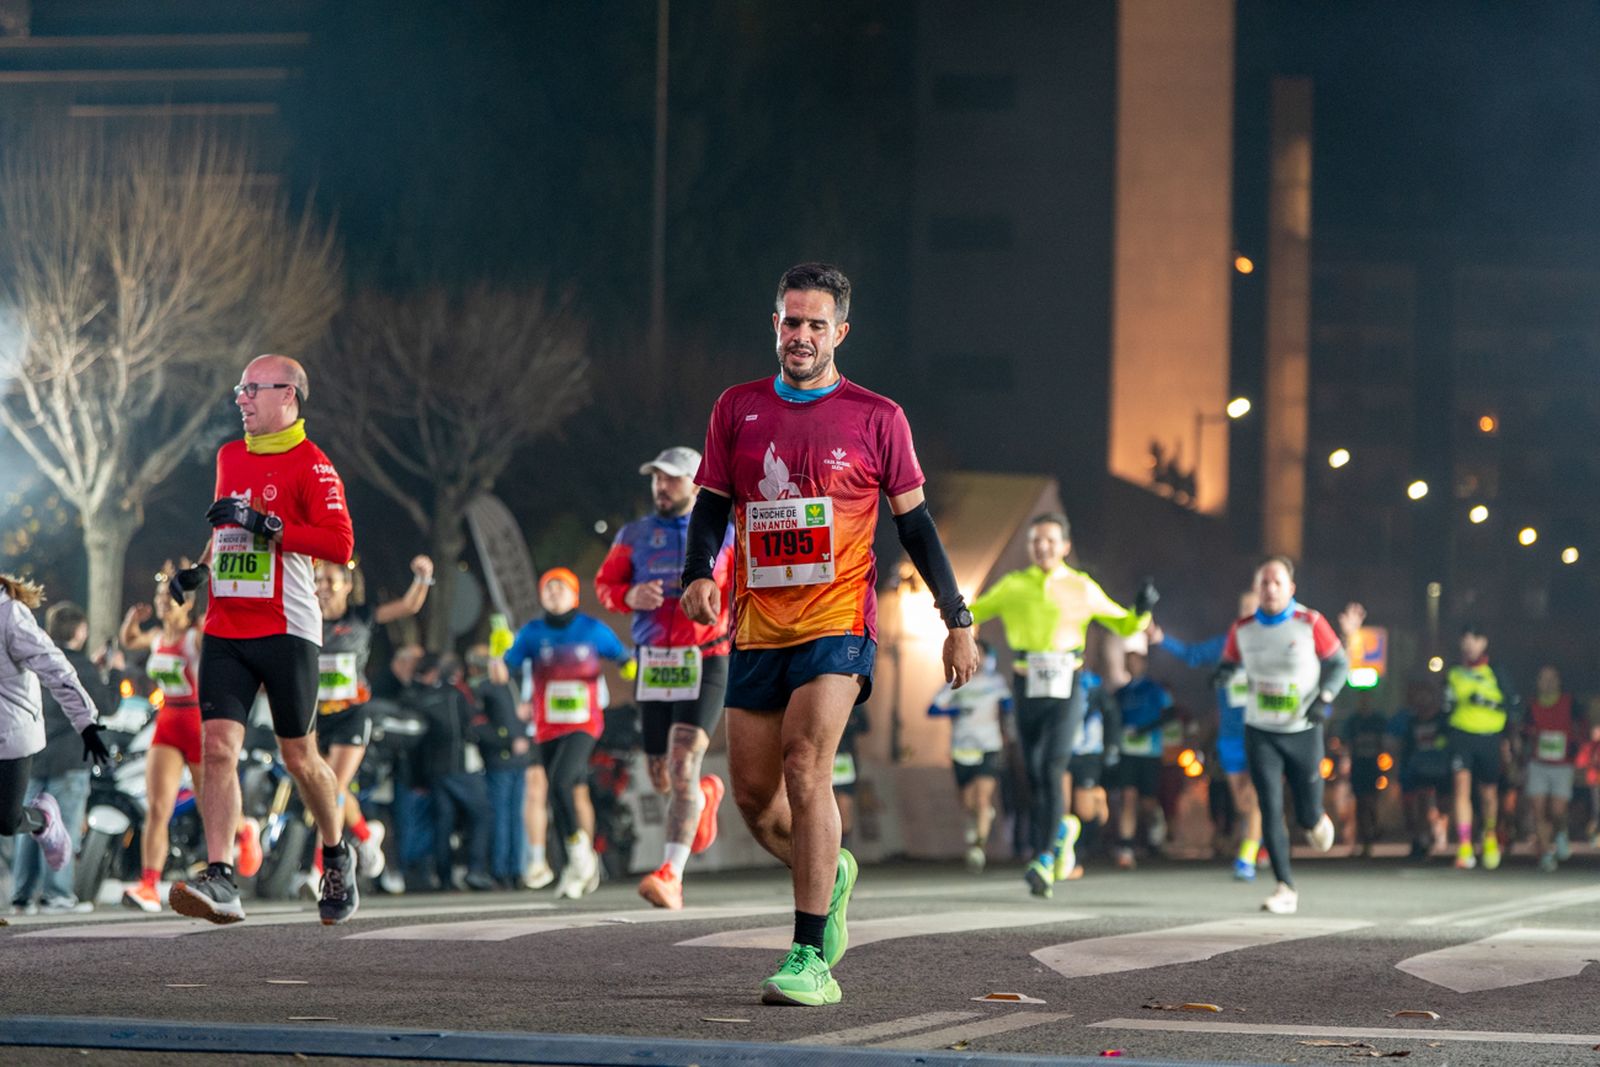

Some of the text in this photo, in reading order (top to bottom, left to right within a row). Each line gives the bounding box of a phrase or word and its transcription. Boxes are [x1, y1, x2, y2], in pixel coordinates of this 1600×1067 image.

[759, 510, 784, 520] NOCHE
[786, 508, 797, 518] DE
[753, 520, 767, 531] SAN
[768, 518, 798, 529] ANTÓN
[761, 530, 814, 557] 1795
[219, 553, 257, 573] 8716
[651, 667, 690, 683] 2059
